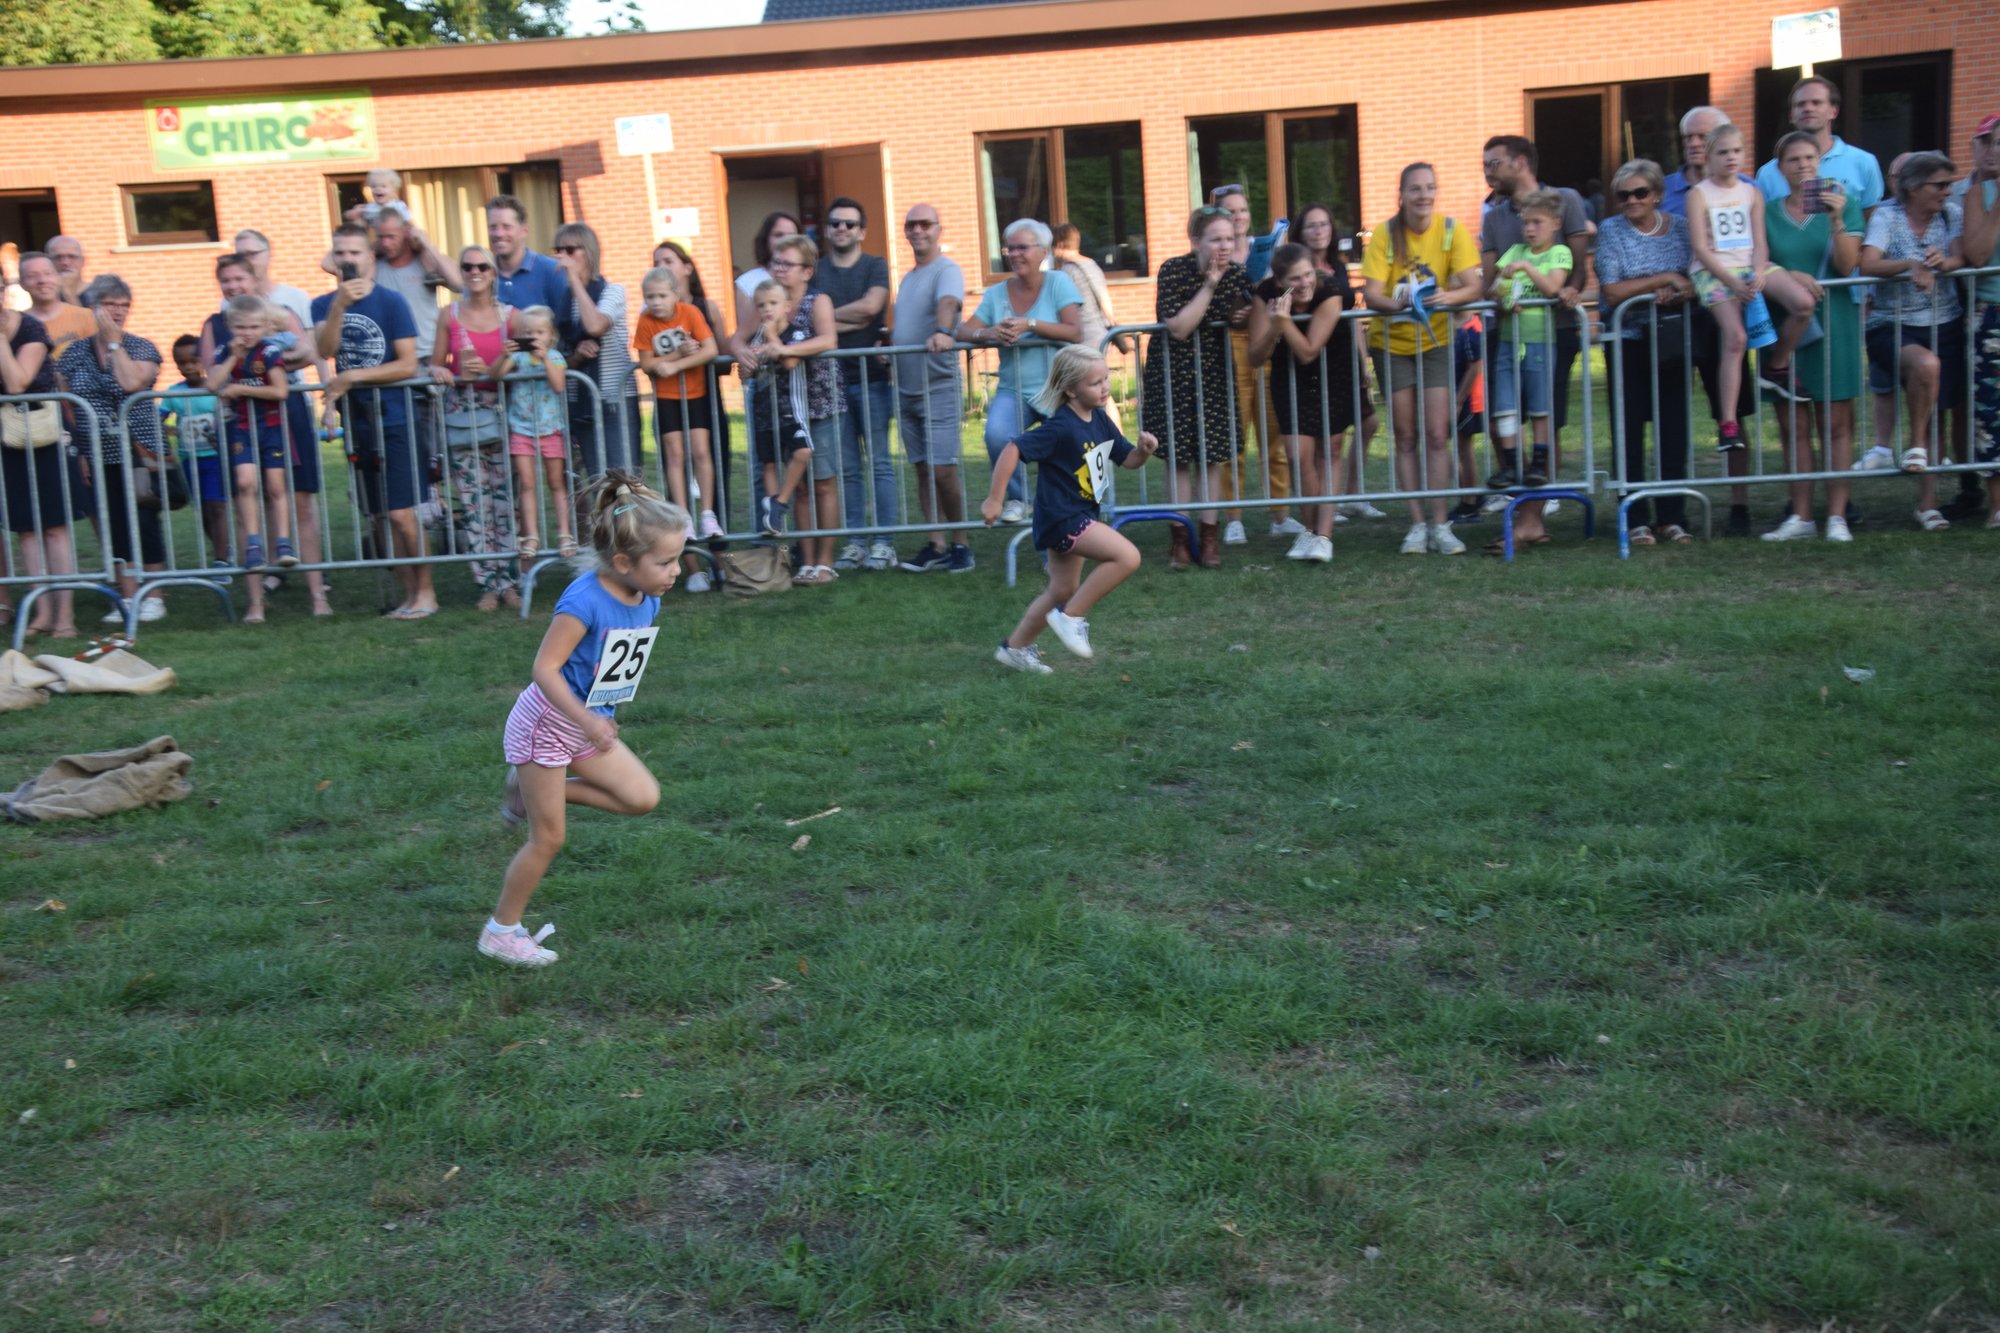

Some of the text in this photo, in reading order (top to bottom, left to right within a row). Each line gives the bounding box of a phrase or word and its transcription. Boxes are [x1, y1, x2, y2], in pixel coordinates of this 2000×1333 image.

[185, 115, 311, 157] CHIRO
[1717, 210, 1745, 236] 89
[1095, 451, 1104, 481] 9
[599, 636, 650, 683] 25
